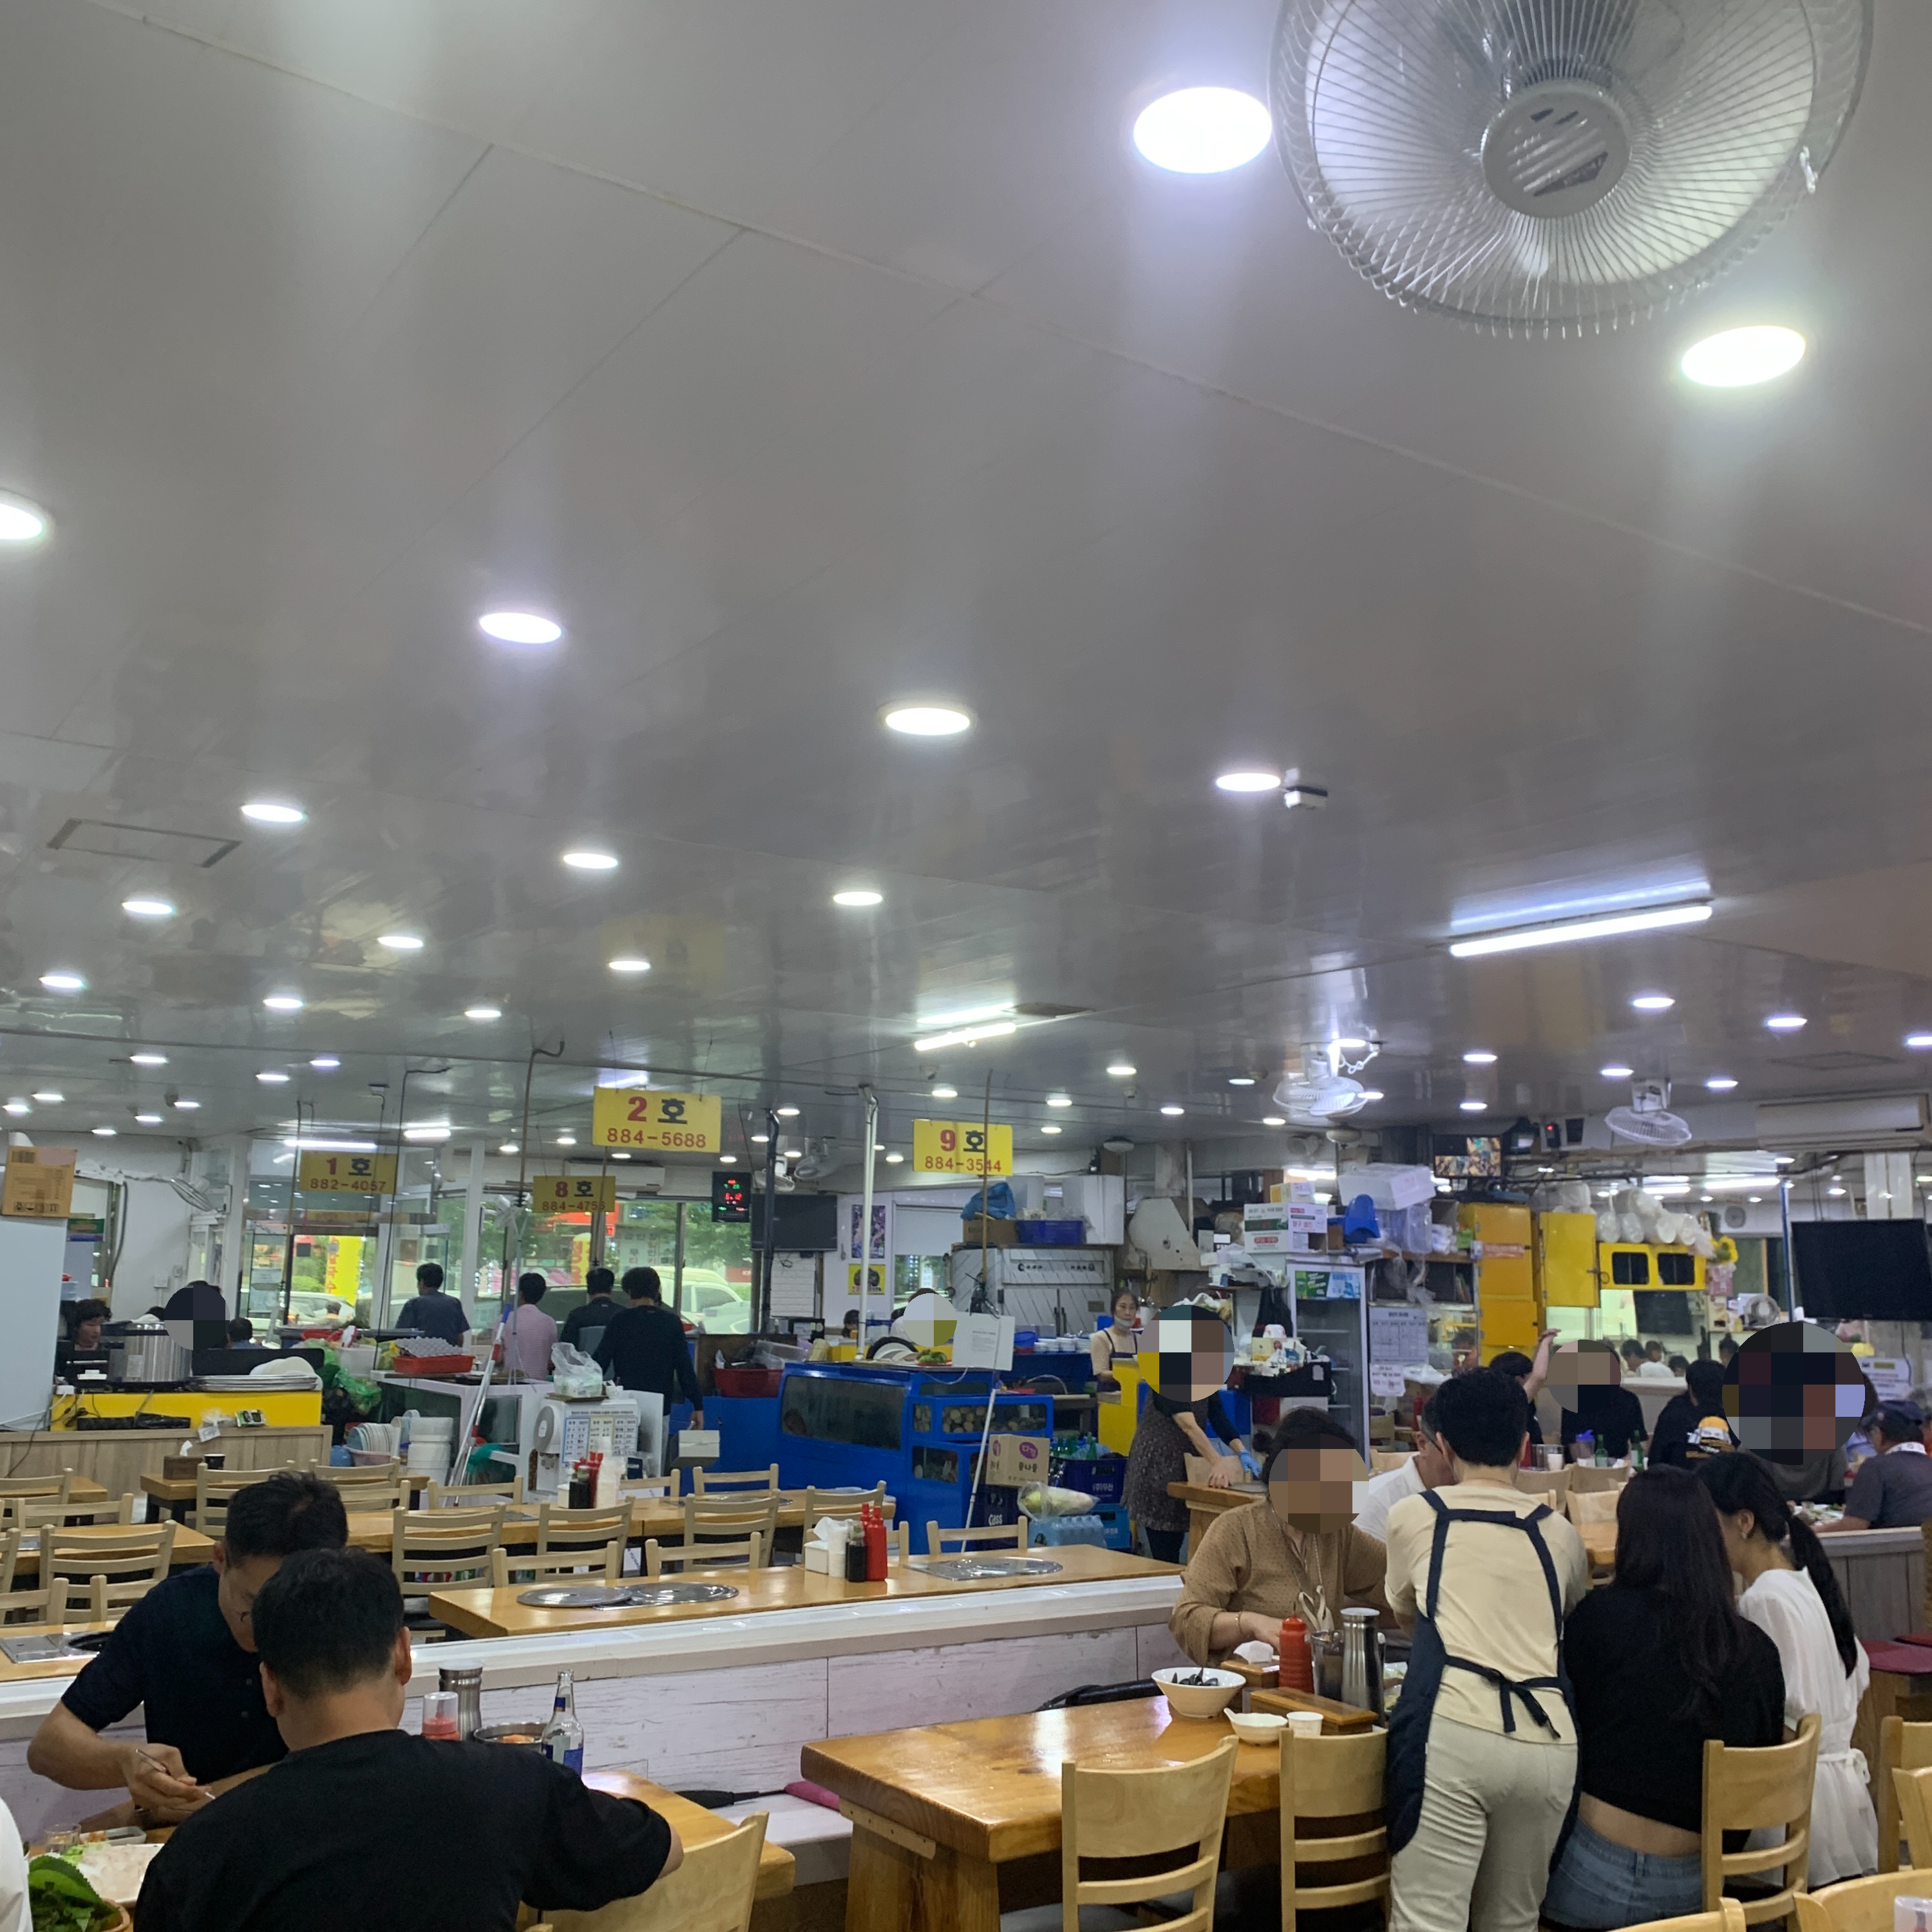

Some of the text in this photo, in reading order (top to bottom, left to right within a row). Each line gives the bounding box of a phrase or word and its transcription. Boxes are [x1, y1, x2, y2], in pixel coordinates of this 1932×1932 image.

[627, 1096, 688, 1124] 2 호
[607, 1128, 706, 1148] 884-5688
[940, 1129, 986, 1152] 9 호
[327, 1157, 372, 1176] 1 호
[925, 1155, 1001, 1171] 884-3544
[555, 1180, 594, 1198] 8 호
